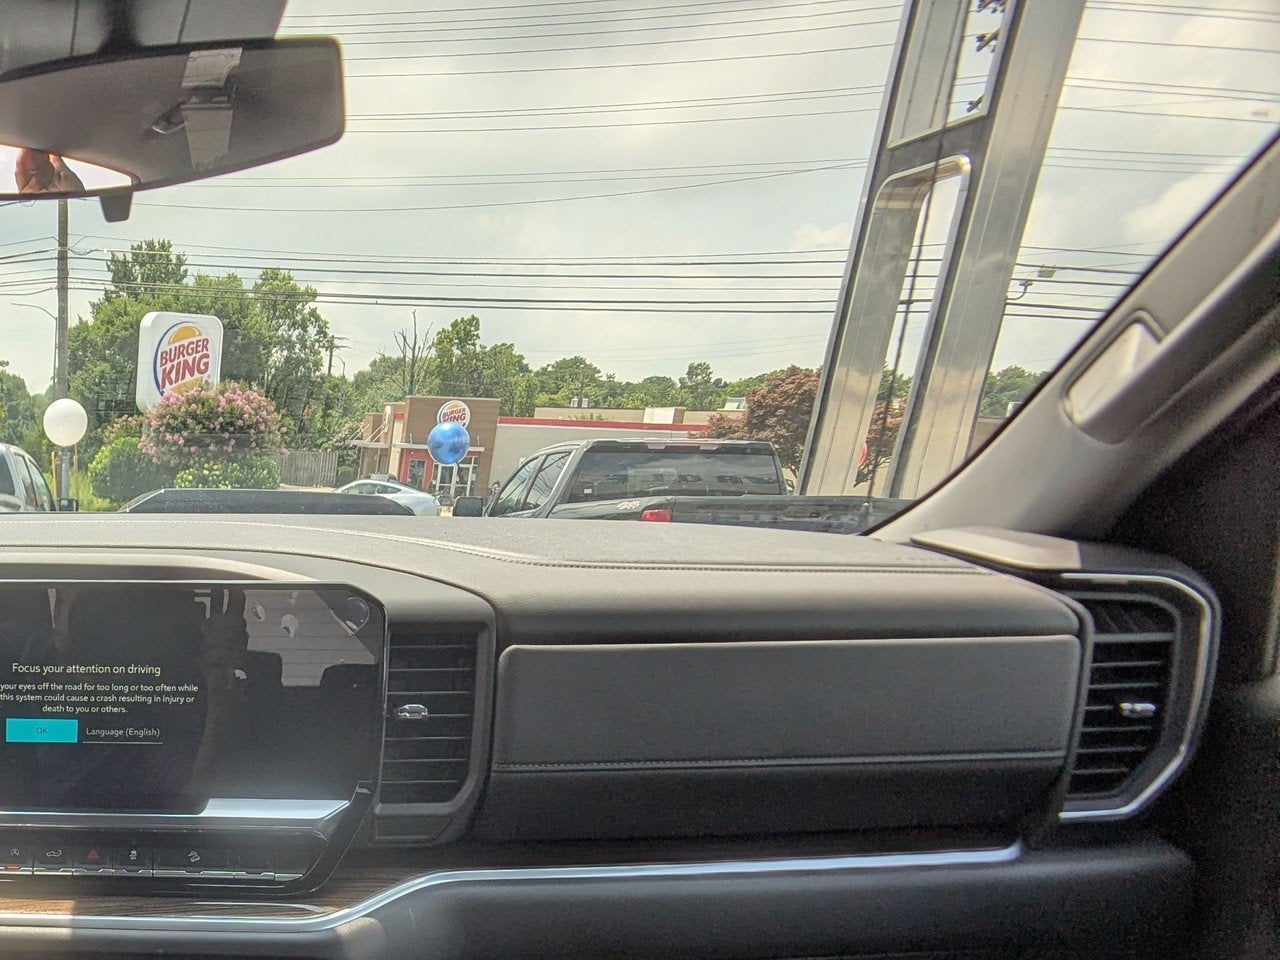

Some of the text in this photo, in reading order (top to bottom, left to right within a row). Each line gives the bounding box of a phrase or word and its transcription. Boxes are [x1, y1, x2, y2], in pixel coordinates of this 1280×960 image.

[160, 337, 210, 368] BURGER
[160, 353, 210, 390] KING
[442, 407, 466, 418] BURGER
[12, 662, 161, 677] Focus your attention on driving
[0, 683, 17, 692] your
[18, 683, 36, 692] eyes
[37, 682, 49, 690] off
[50, 682, 64, 690] the
[64, 682, 82, 691] road
[83, 682, 95, 691] for
[111, 683, 129, 693] long
[155, 683, 176, 692] often
[177, 683, 199, 692] while
[0, 693, 14, 701] this
[15, 694, 42, 702] system
[43, 693, 65, 701] could
[96, 694, 117, 702] crash
[118, 694, 152, 704] resulting
[153, 694, 161, 702] in
[162, 695, 185, 705] injury
[42, 704, 65, 712] death
[66, 705, 74, 713] to
[75, 706, 89, 714] you
[100, 705, 128, 713] others.
[35, 727, 48, 735] OK
[85, 727, 160, 738] Language (English)
